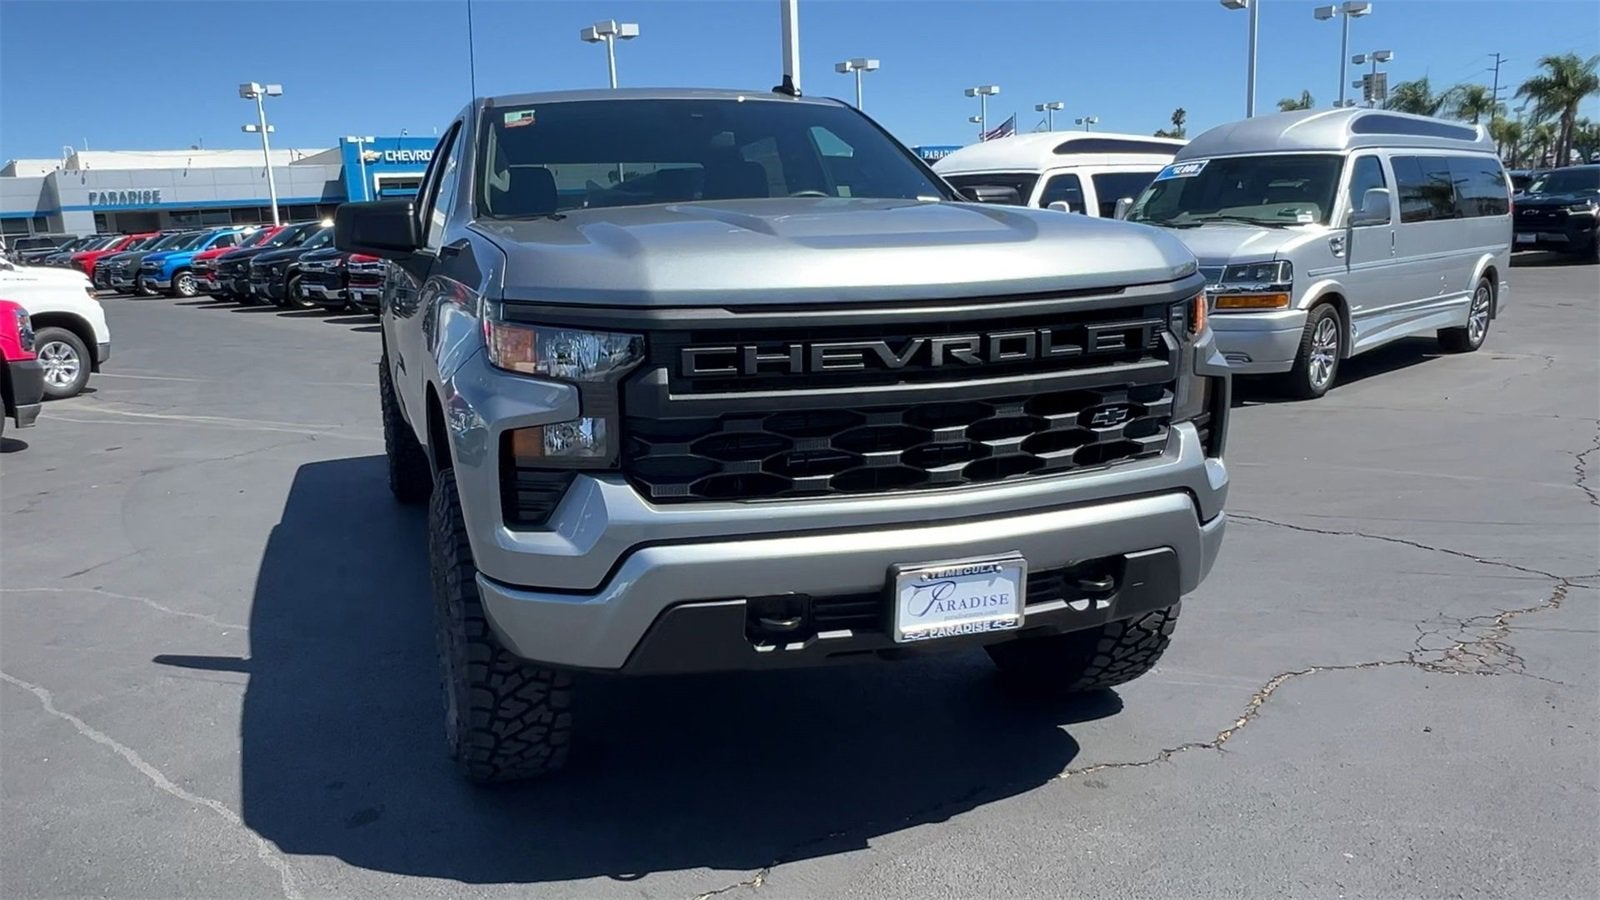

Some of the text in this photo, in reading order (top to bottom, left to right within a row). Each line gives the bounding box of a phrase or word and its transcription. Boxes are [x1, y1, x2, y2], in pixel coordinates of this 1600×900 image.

[88, 190, 161, 206] PARADISE
[681, 320, 1164, 376] CHEVROLET
[930, 565, 995, 579] TEMECULA
[929, 620, 991, 638] PARADISE
